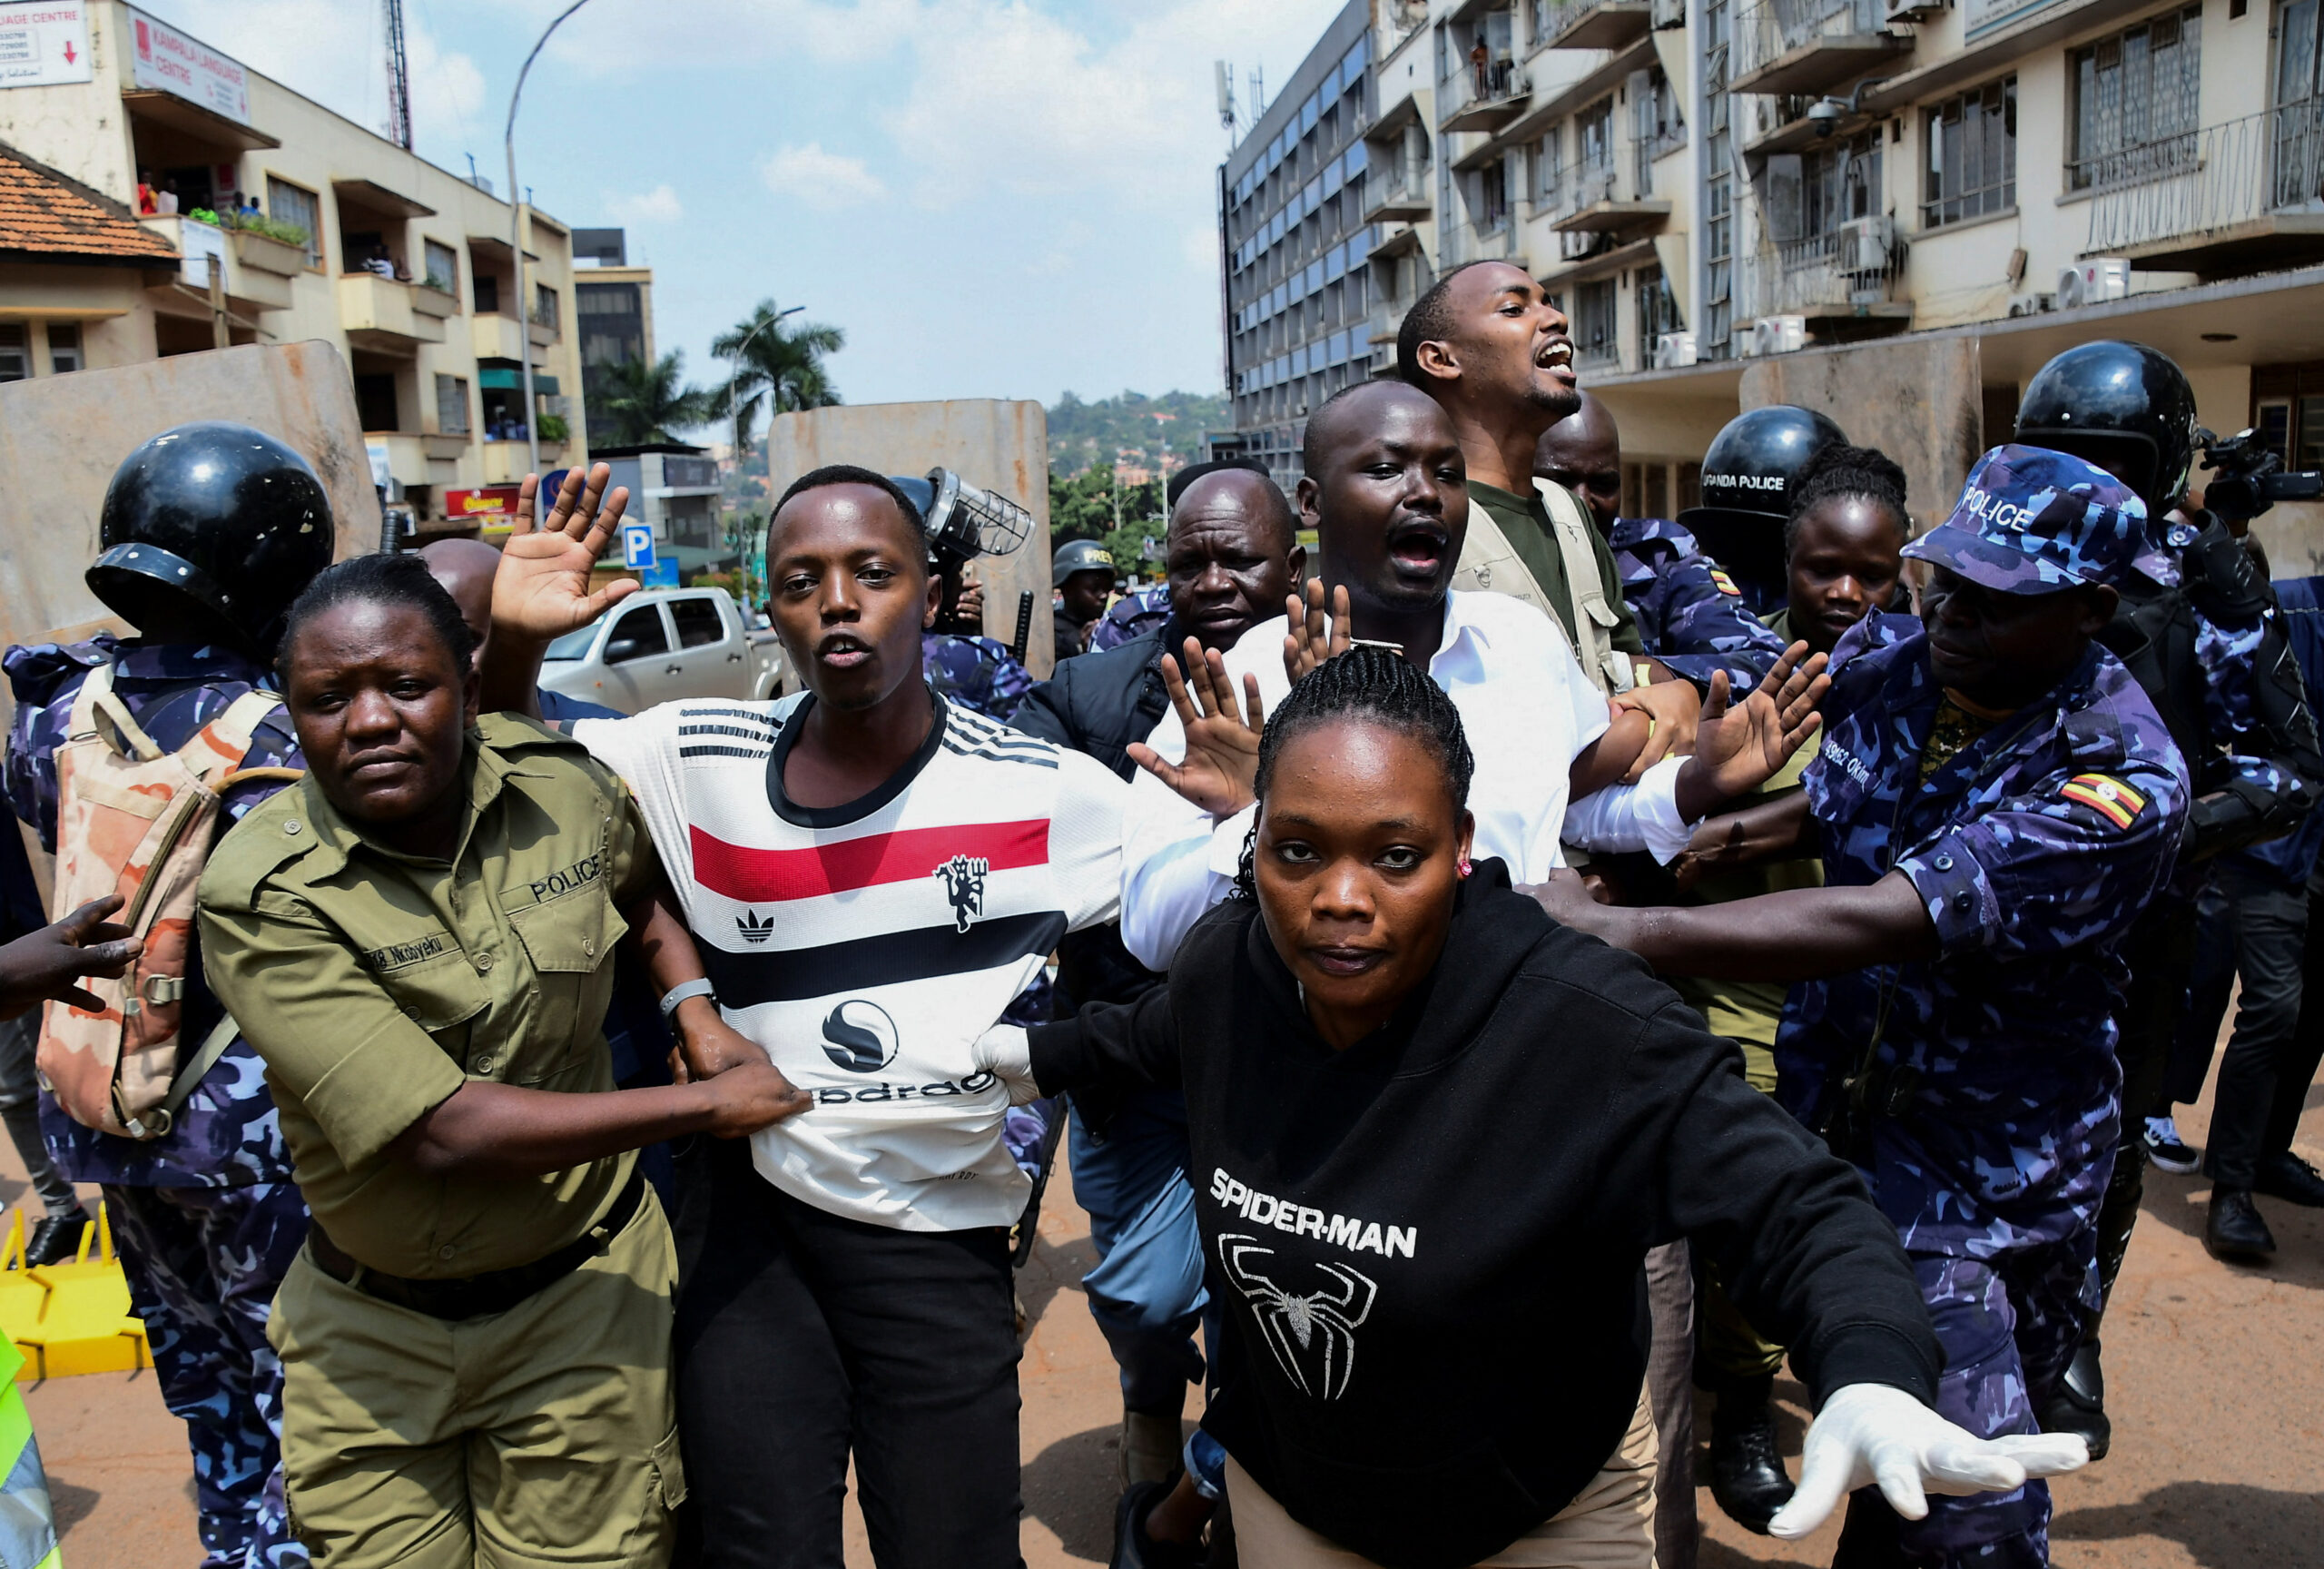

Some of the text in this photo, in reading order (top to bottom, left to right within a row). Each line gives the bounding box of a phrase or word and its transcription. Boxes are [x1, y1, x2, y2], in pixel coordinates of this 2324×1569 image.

[32, 10, 78, 24] CENTRE
[153, 26, 197, 63] KAMPALA
[199, 54, 243, 86] LANGUAGE
[156, 55, 192, 86] CENTRE
[1703, 474, 1785, 491] UGANDA POLICE
[1962, 486, 2035, 532] POLICE
[626, 528, 650, 565] P
[531, 854, 601, 903] POLICE
[1209, 1168, 1417, 1258] SPIDER-MAN
